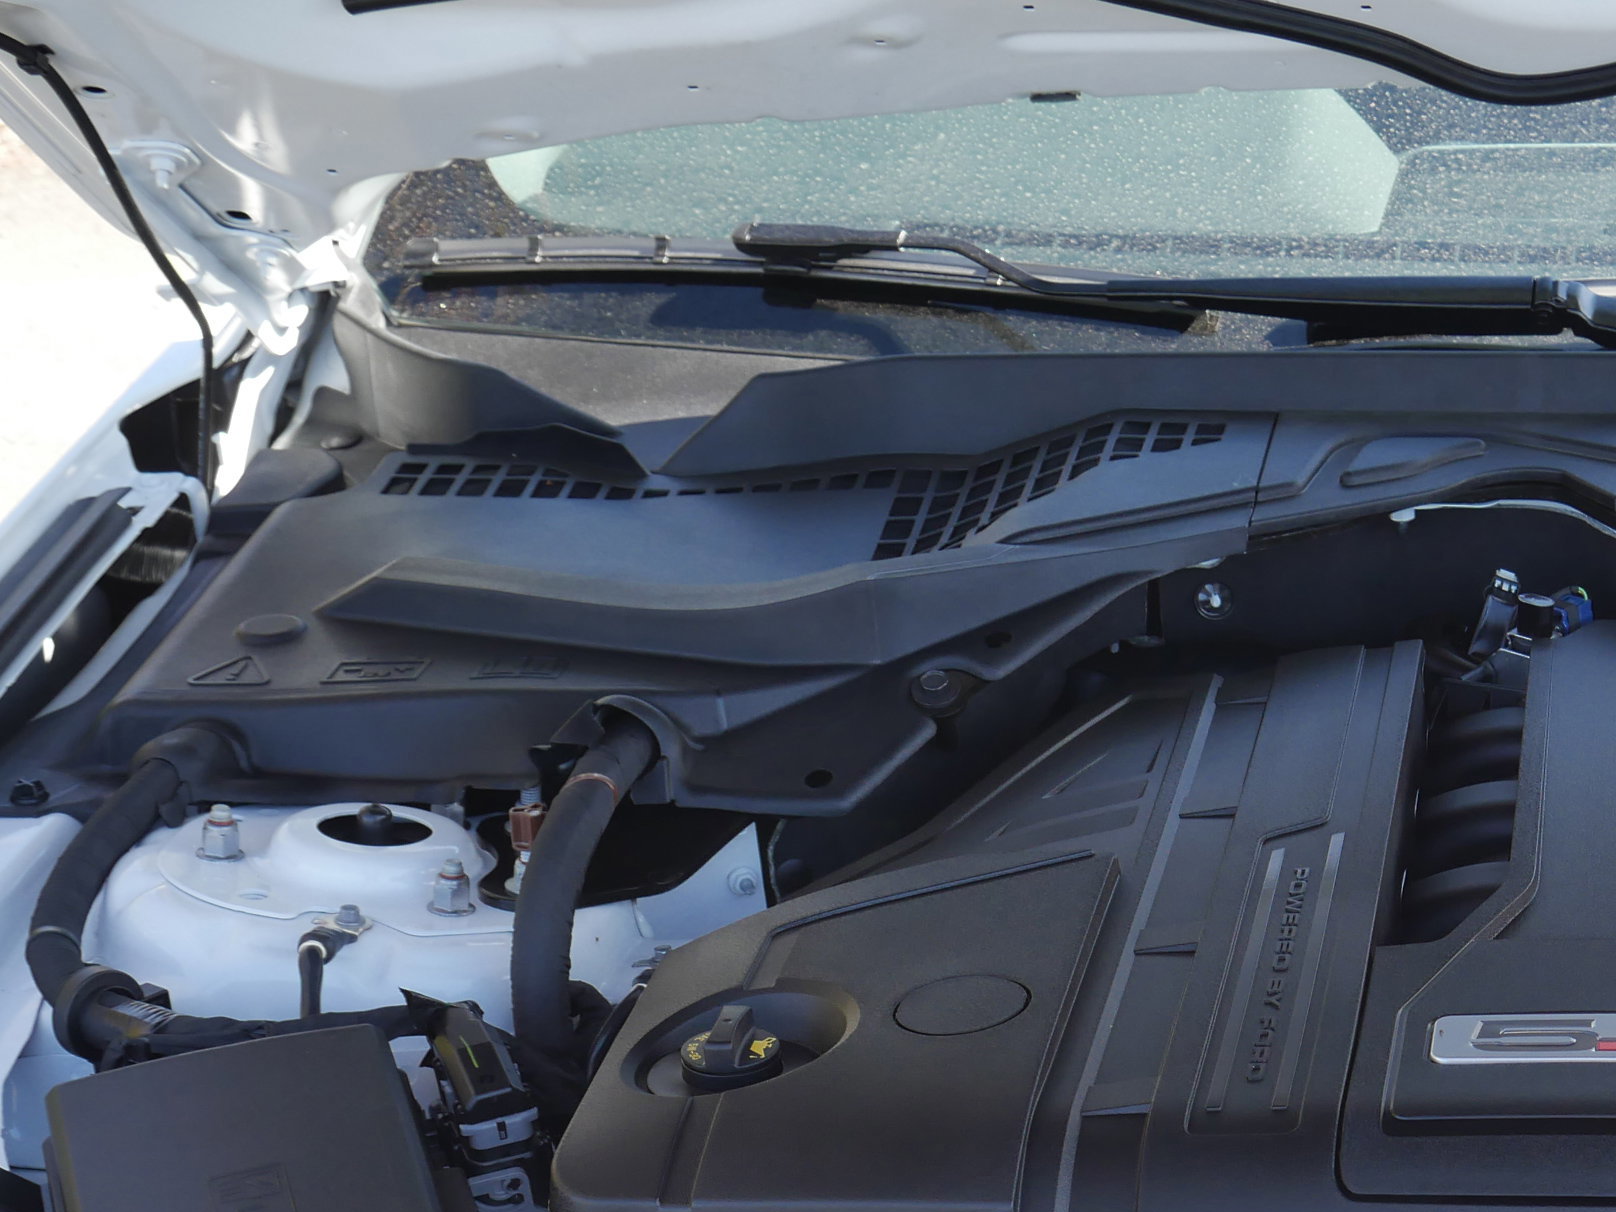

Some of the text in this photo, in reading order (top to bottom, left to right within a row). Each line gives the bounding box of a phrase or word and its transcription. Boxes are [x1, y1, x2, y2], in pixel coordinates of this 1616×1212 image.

[1246, 867, 1310, 1084] POWERED BY FORD
